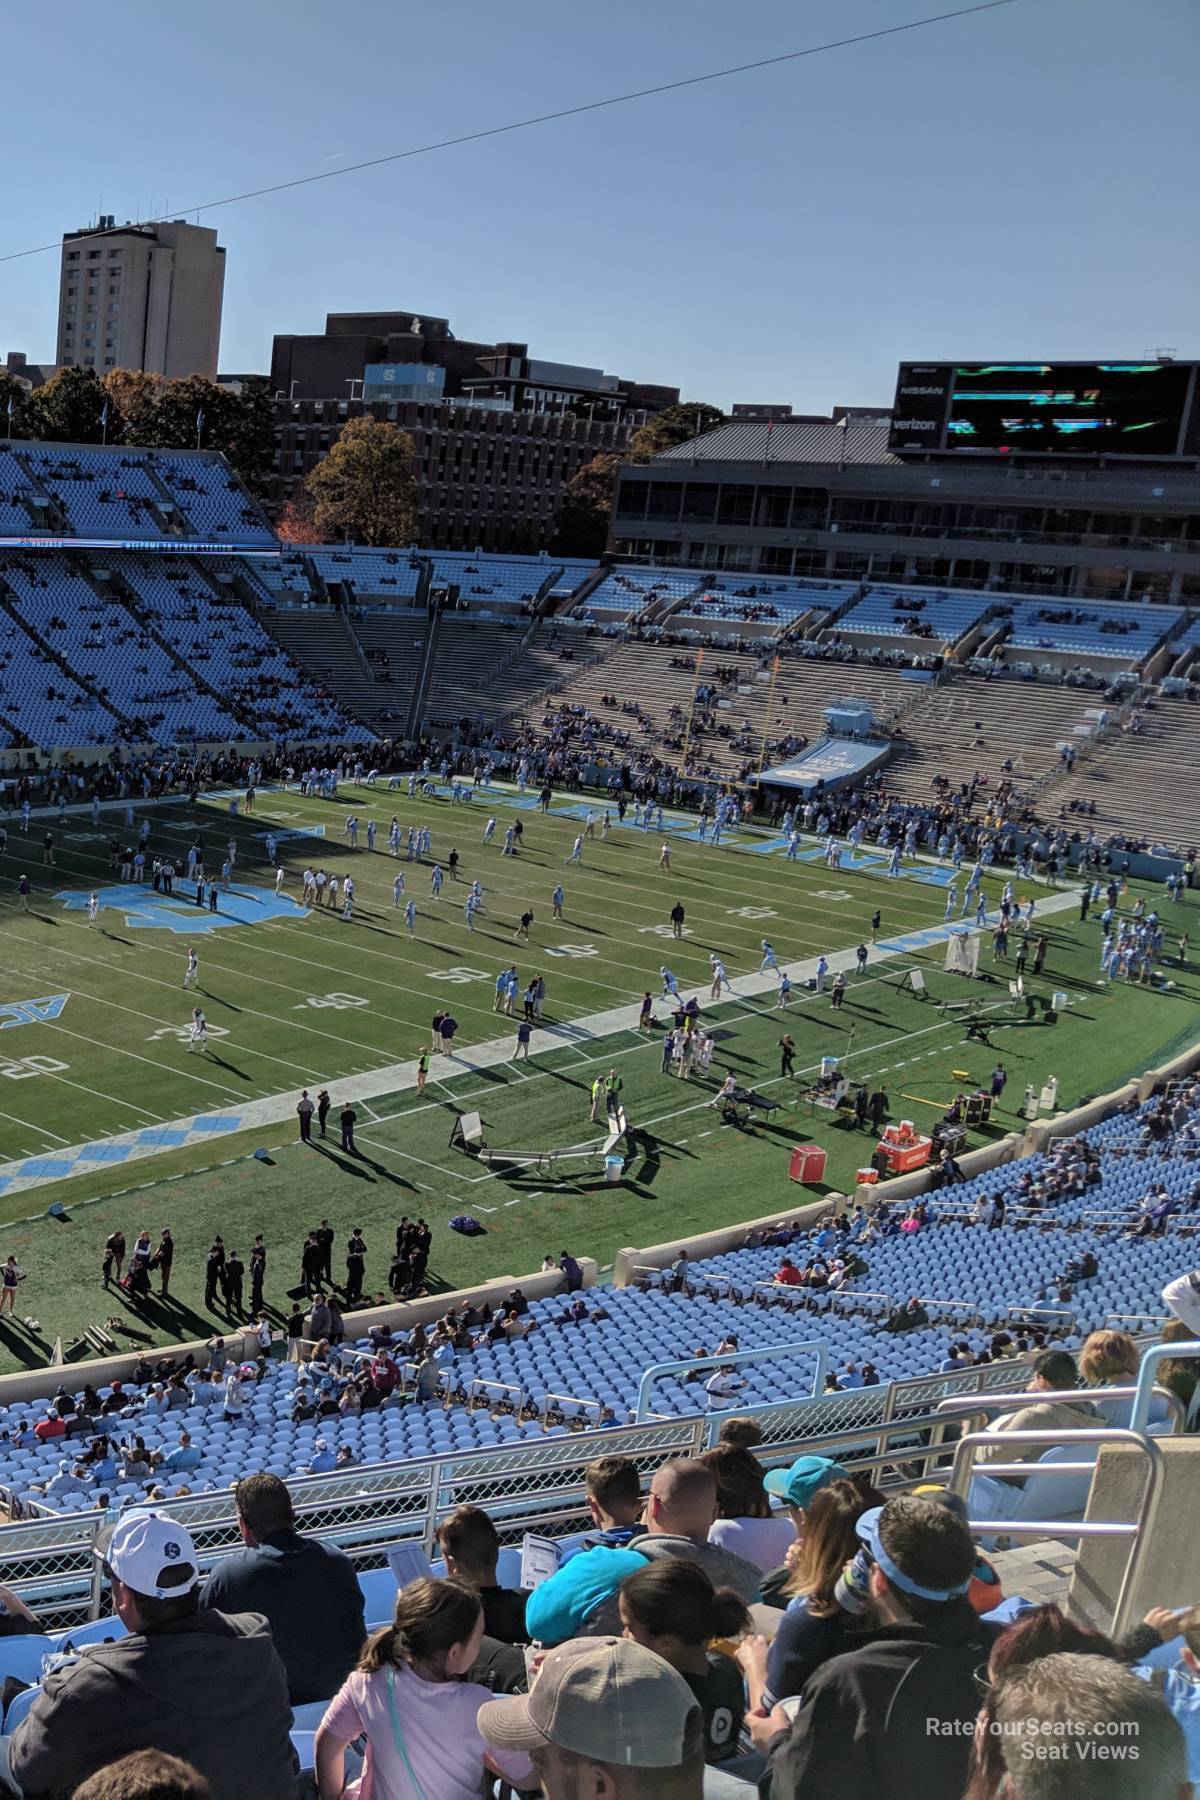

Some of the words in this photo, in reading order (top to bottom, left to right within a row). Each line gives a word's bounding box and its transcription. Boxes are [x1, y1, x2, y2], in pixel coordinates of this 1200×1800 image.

[900, 387, 944, 395] NISSAN
[893, 418, 936, 430] verizon
[424, 966, 493, 984] 50
[306, 992, 371, 1010] 40
